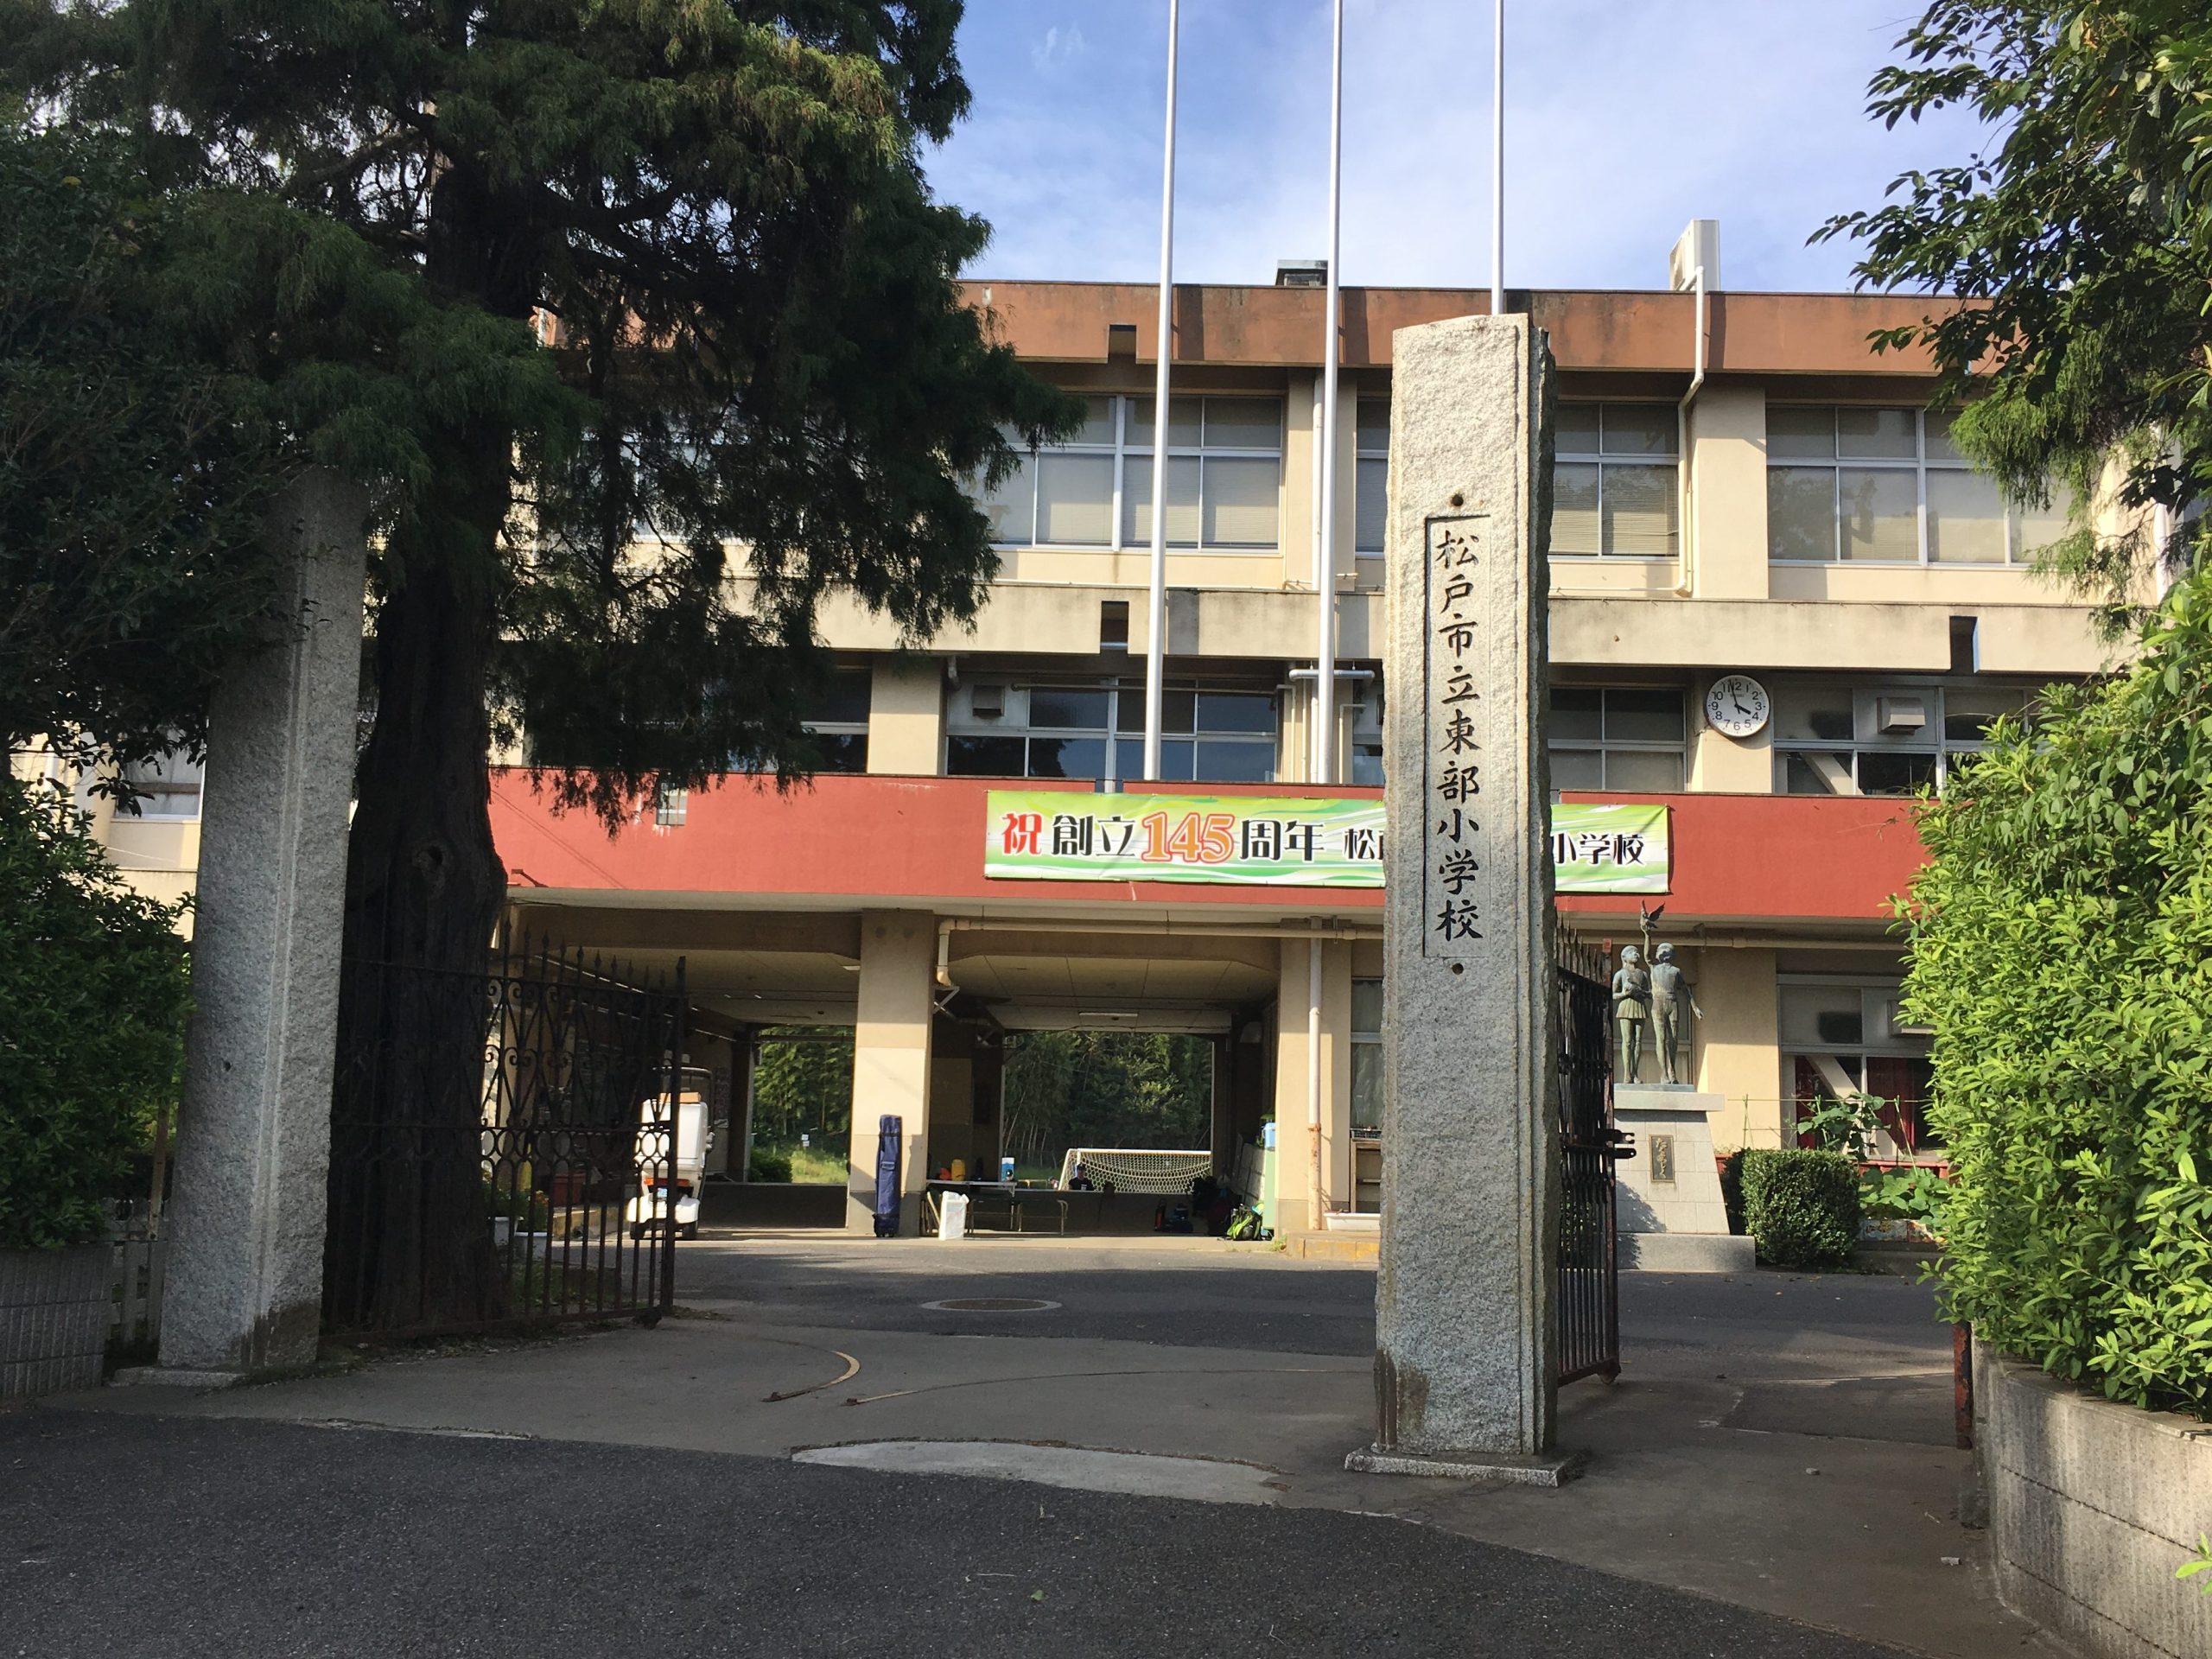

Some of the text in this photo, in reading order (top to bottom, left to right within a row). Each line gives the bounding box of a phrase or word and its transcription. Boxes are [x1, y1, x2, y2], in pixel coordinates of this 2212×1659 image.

[1745, 683, 1749, 693] 1
[1712, 691, 1724, 701] 10
[1752, 691, 1759, 701] 2
[1712, 702, 1719, 710] 9
[1755, 702, 1762, 711] 3
[1715, 711, 1722, 720] 8
[1752, 712, 1759, 721] 4
[1724, 719, 1731, 728] 7
[1733, 721, 1740, 730] 6
[1745, 719, 1751, 728] 5
[1435, 530, 1484, 942] 松戸市立東部小学校
[1052, 811, 1325, 863] 創立145周年
[1344, 828, 1384, 861] 松
